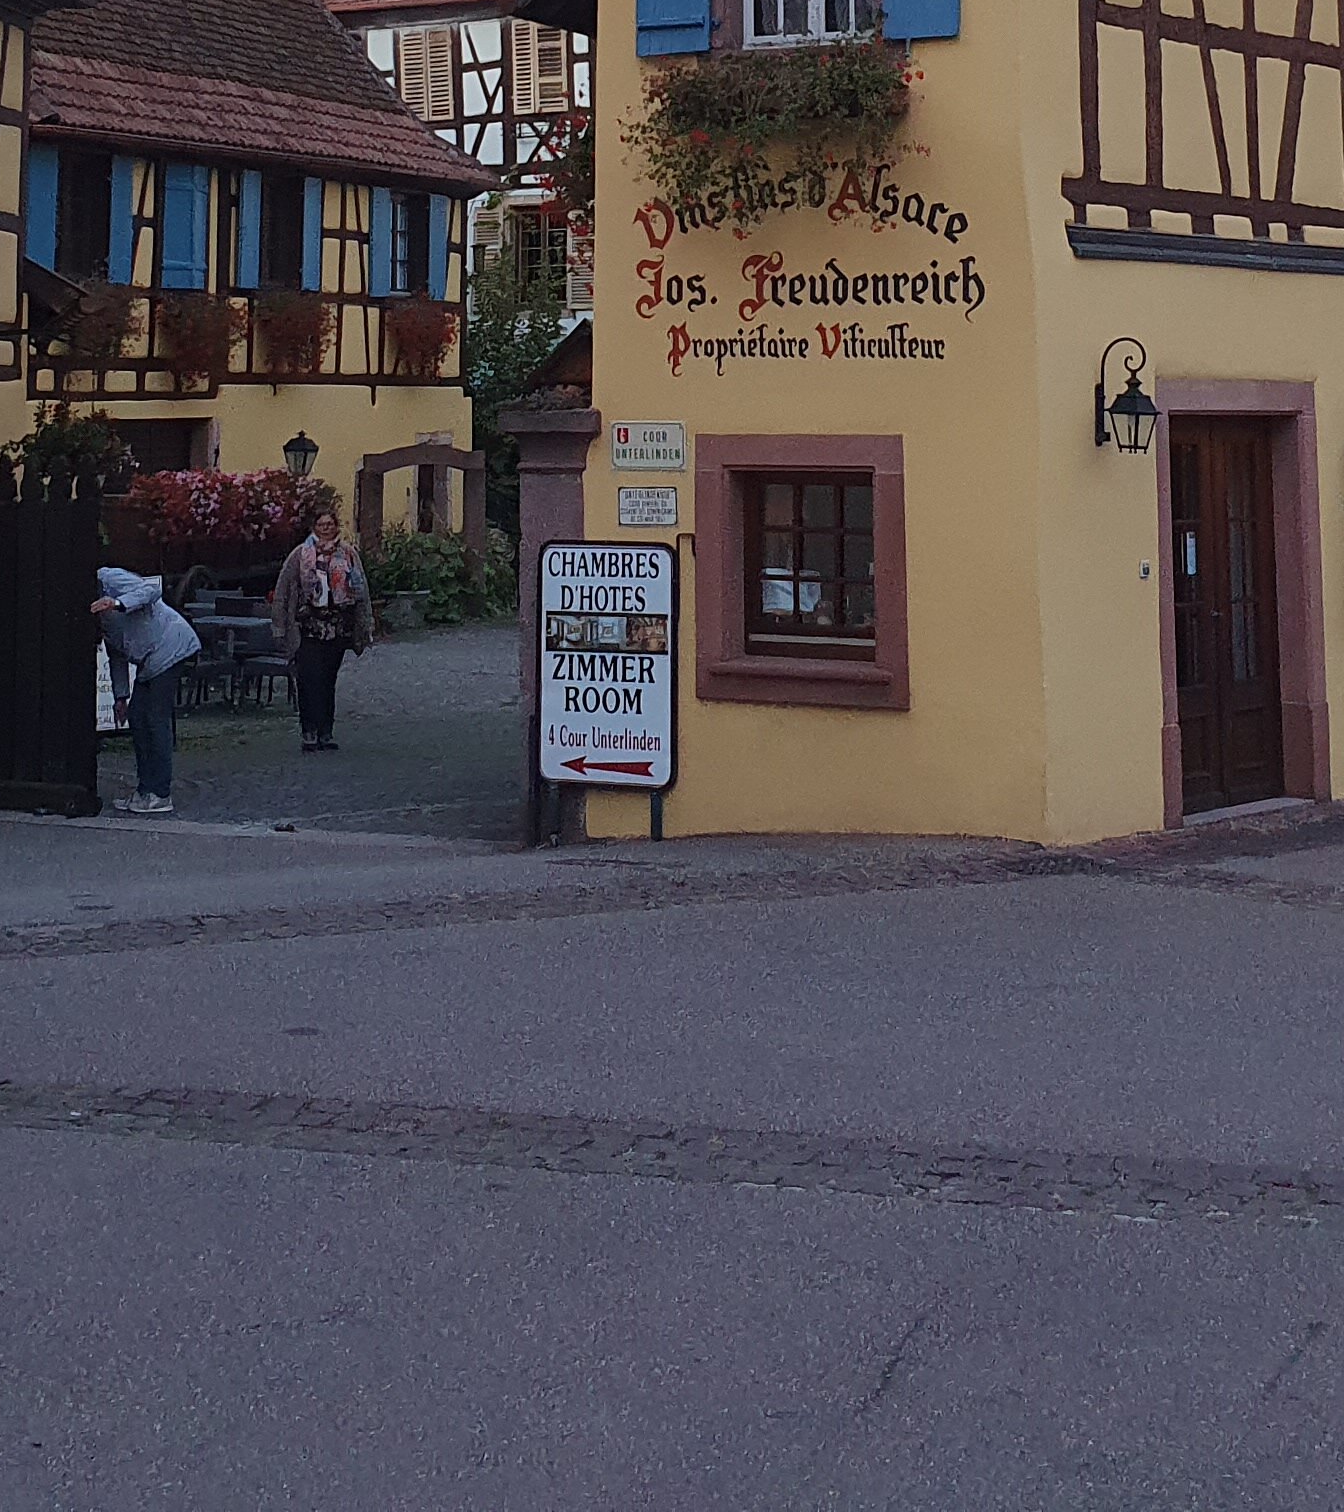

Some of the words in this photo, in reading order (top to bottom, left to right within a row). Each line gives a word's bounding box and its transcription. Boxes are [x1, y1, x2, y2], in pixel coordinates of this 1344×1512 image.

[636, 254, 718, 319] Jos.
[738, 251, 985, 324] Freudenreich
[666, 321, 809, 377] Propriétaire
[814, 322, 945, 360] Viticulteur
[643, 431, 668, 443] COUR
[616, 448, 681, 460] UNTERLINDEN
[548, 551, 660, 579] CHAMBRES
[560, 585, 646, 612] D'HOTES
[552, 653, 655, 683] ZIMMER
[564, 686, 643, 715] ROOM
[548, 724, 555, 745] 4
[559, 724, 587, 748] Cour
[592, 726, 661, 751] Unterlinden
